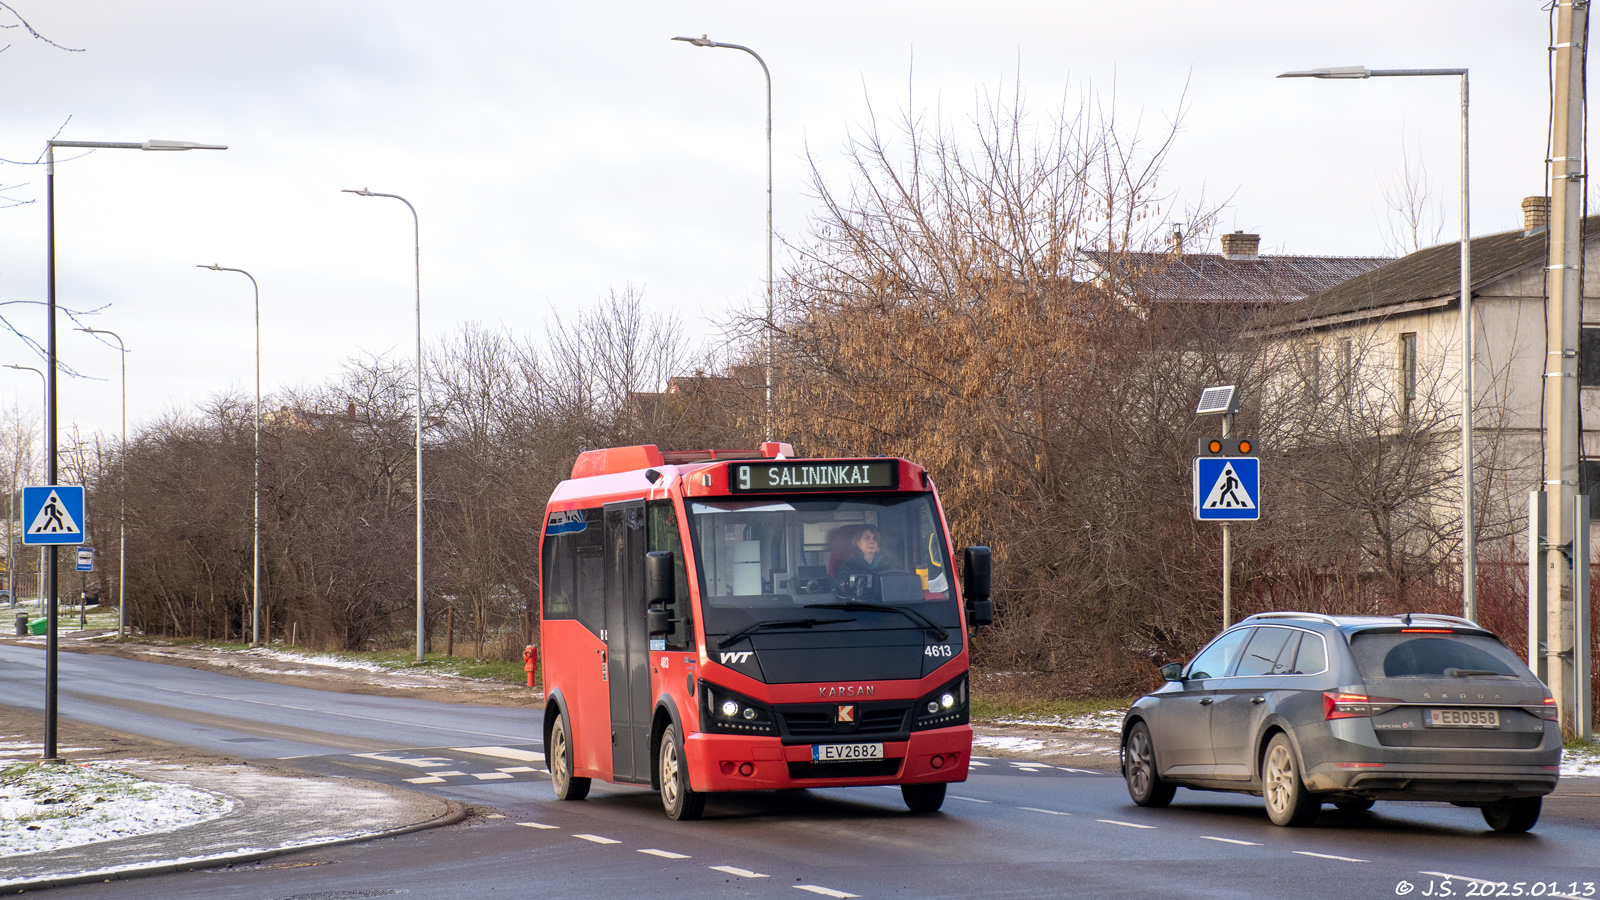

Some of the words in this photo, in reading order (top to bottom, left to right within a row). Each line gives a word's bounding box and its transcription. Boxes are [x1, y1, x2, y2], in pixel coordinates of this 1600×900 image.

[739, 465, 751, 489] 9
[768, 465, 870, 486] SALININKAI
[924, 645, 952, 657] 4613
[819, 685, 874, 697] KARSAN
[1441, 711, 1496, 724] EB0958
[825, 745, 877, 759] EV2682
